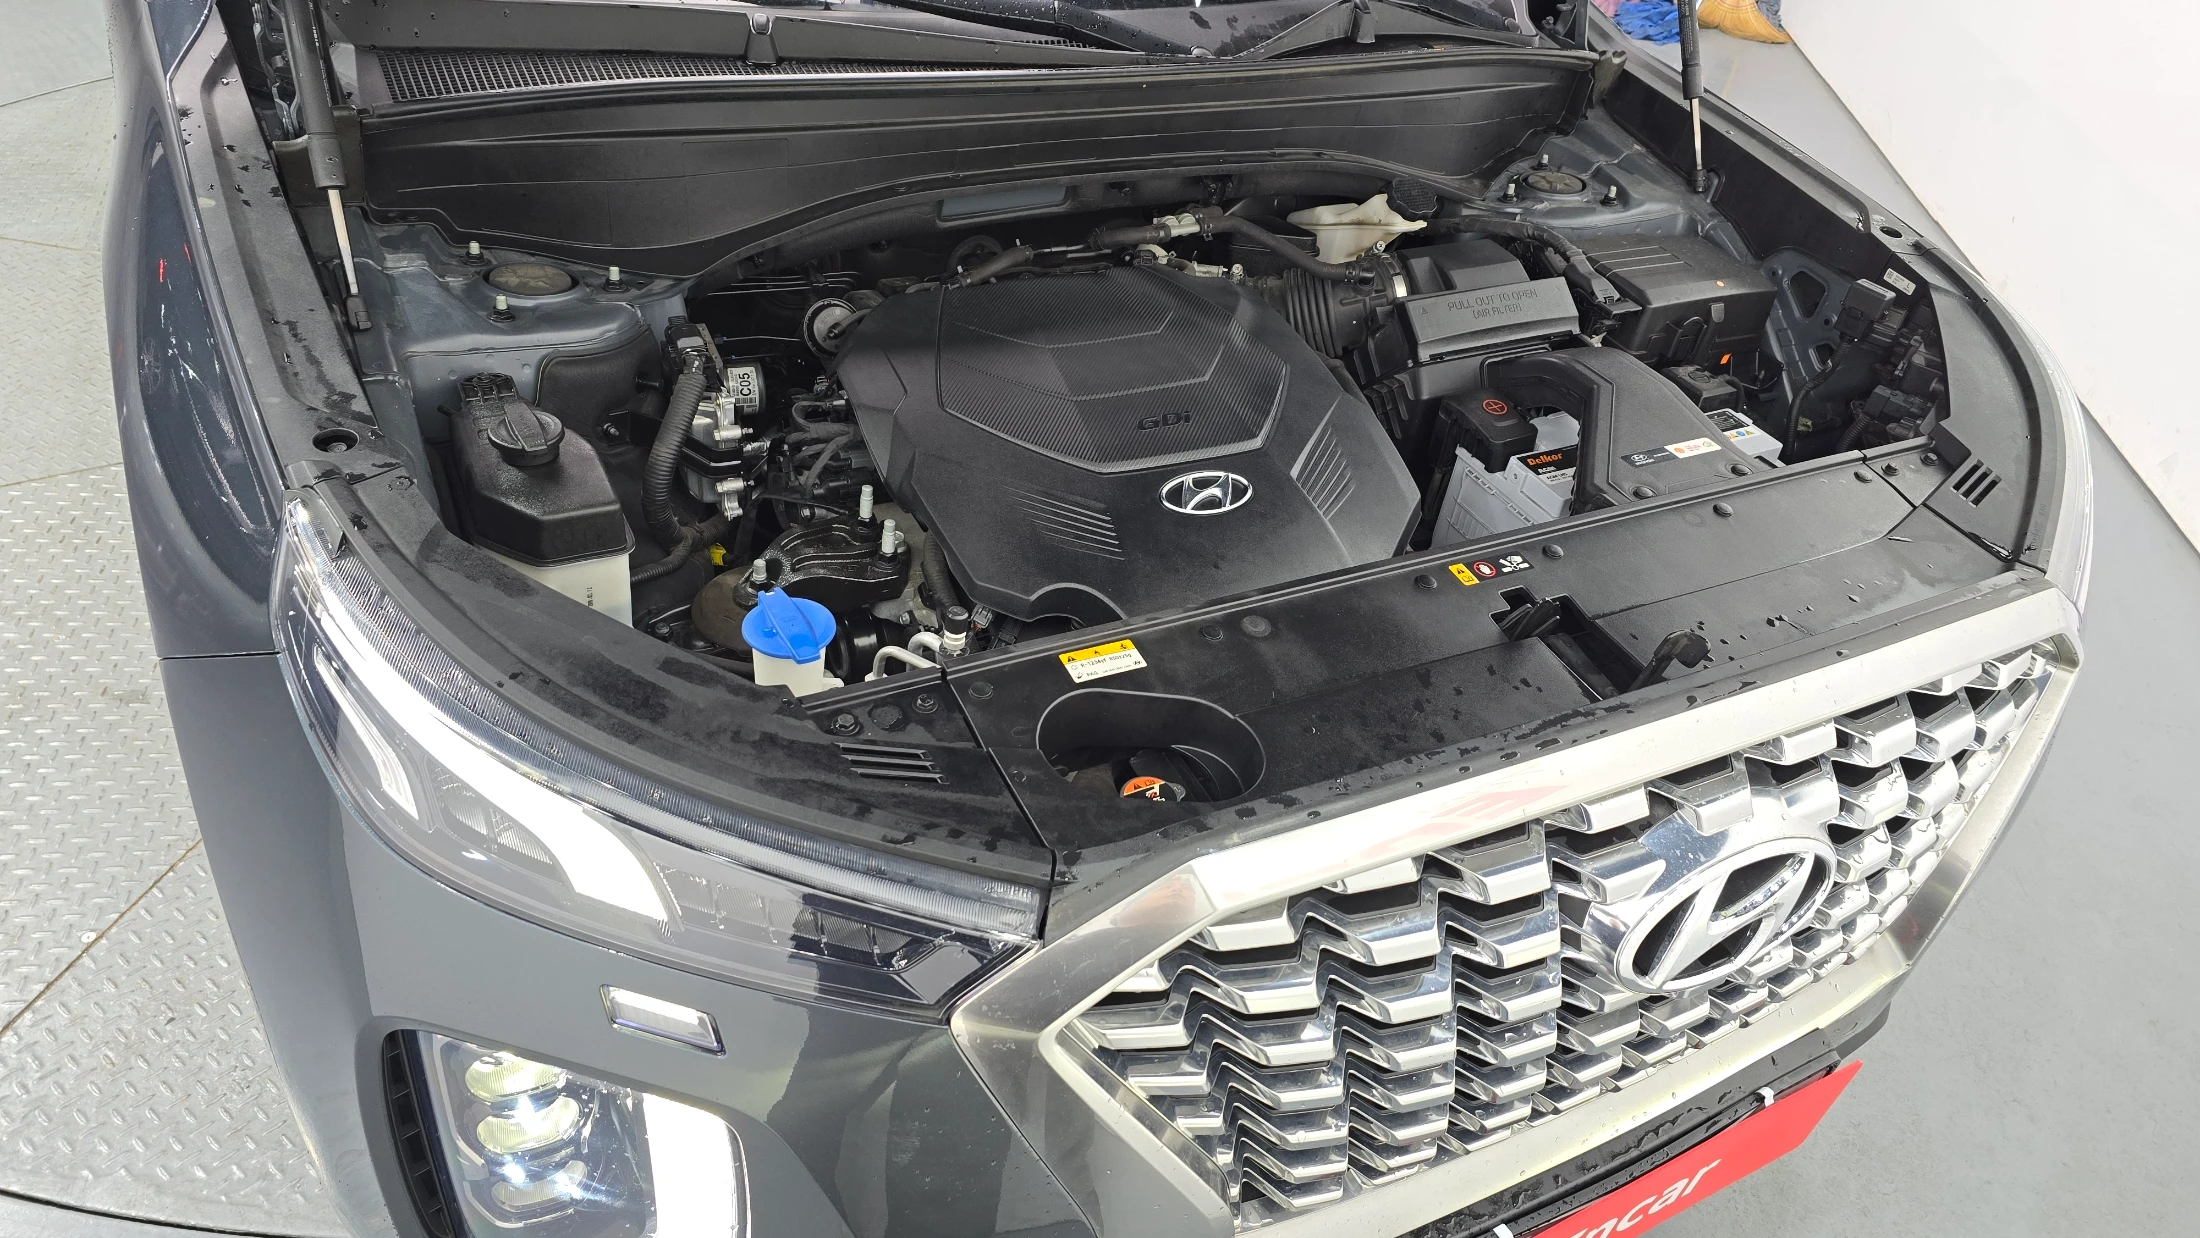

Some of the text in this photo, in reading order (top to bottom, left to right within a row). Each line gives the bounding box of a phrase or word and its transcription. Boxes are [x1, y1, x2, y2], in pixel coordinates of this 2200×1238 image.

[1447, 288, 1538, 312] PULL OUT TO OPEN
[738, 372, 752, 397] C05
[1137, 410, 1191, 432] GDi
[1526, 452, 1563, 466] Delkor
[1570, 1158, 1722, 1238] ncar
